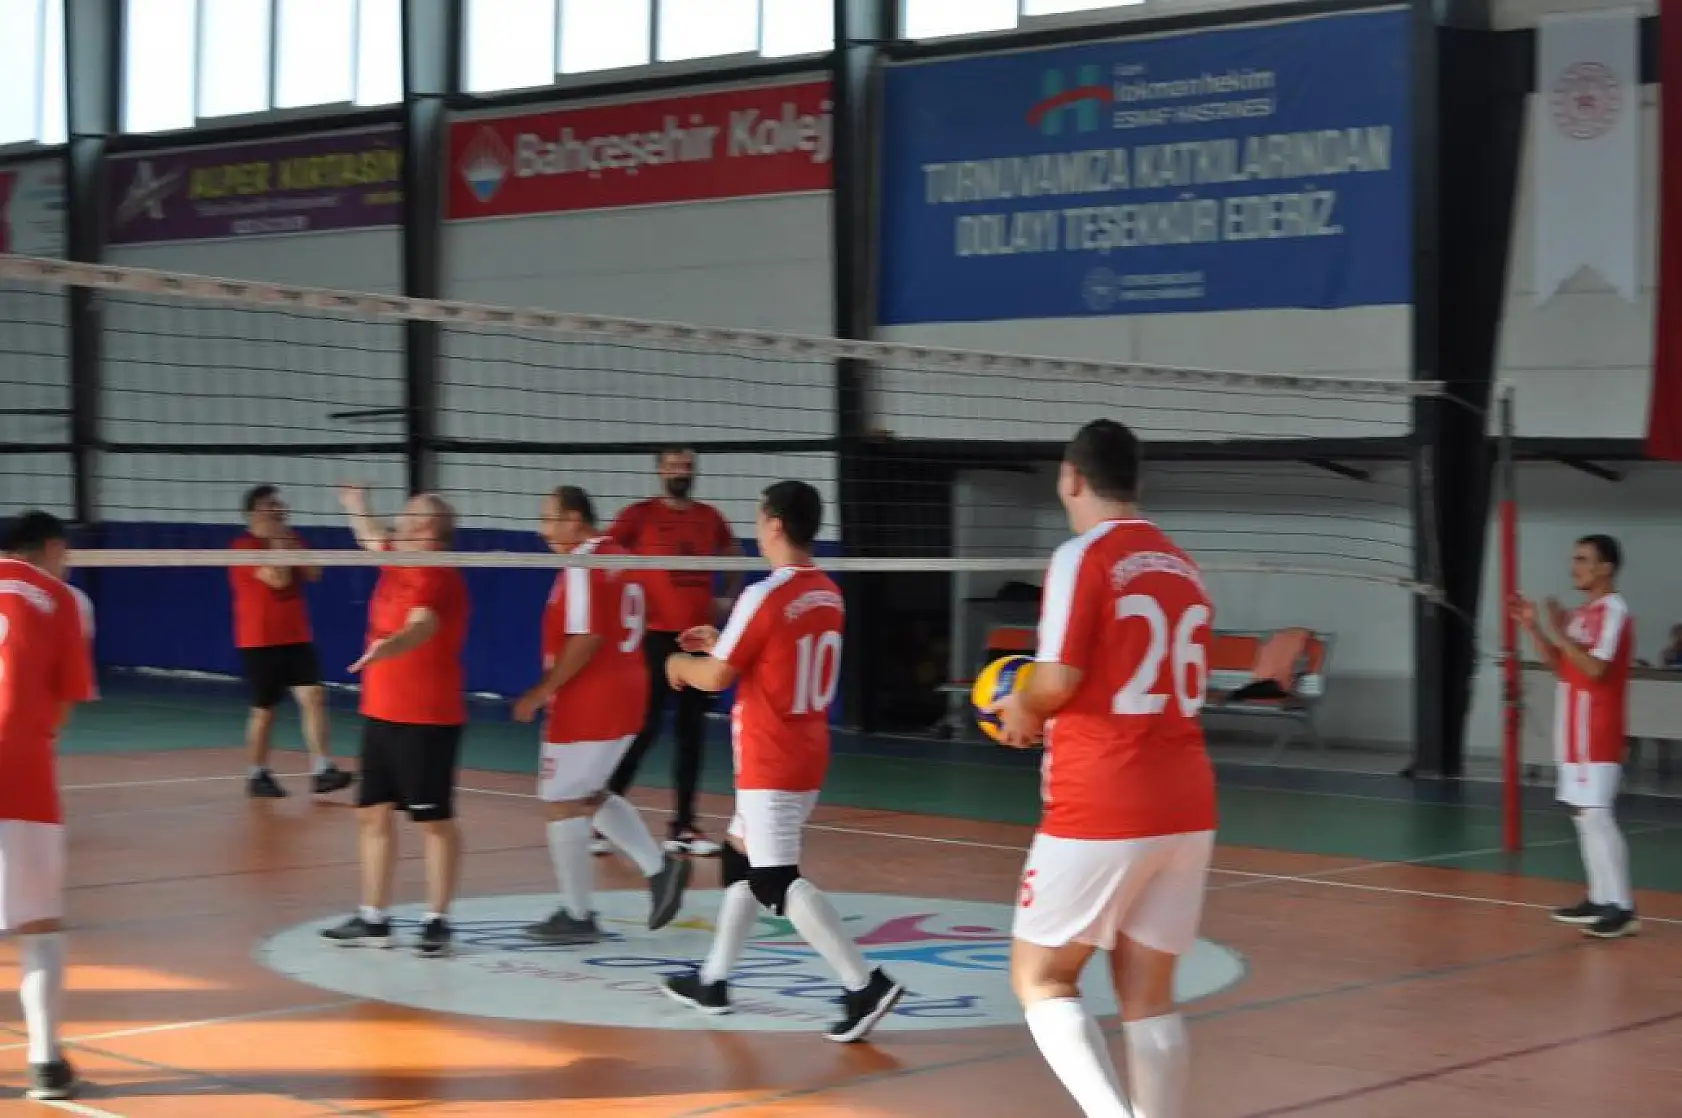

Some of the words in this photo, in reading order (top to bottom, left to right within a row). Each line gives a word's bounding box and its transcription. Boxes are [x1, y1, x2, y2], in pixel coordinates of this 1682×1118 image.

[513, 115, 721, 178] Bahçeşehir
[920, 148, 1130, 204] TURNUVAMIZA
[1133, 125, 1391, 188] KATKILARINDAN
[954, 211, 1058, 257] DOLAYI
[1061, 191, 1220, 254] TEŞEKKÜR
[619, 582, 646, 653] 9
[792, 630, 844, 715] 10
[1112, 594, 1211, 719] 26
